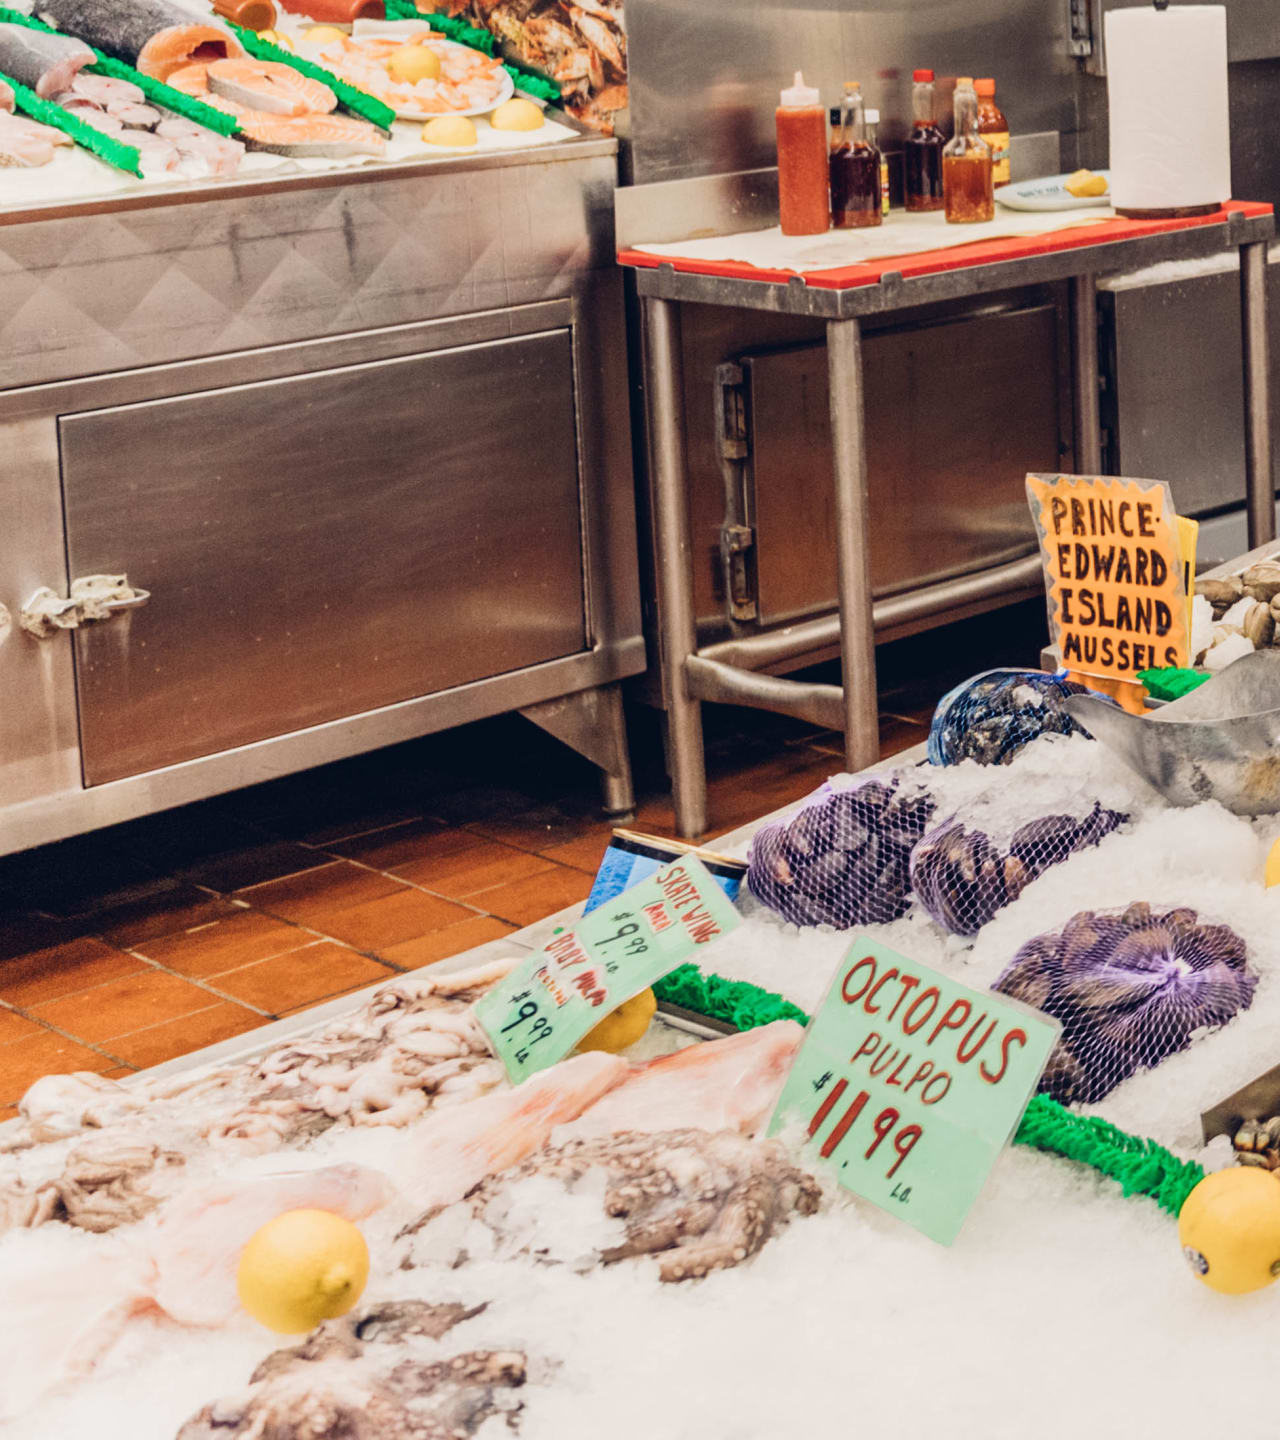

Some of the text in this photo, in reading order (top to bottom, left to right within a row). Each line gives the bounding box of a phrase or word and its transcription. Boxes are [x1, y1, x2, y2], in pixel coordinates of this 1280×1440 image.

[1057, 542, 1168, 588] EDWARD
[1059, 588, 1173, 637] ISLAND
[1063, 632, 1179, 671] MUSSELS
[657, 866, 721, 944] SKATE WING
[841, 956, 1027, 1085] OCTOPUS
[850, 1032, 952, 1106] PULPO
[808, 1071, 923, 1180] $11.99
